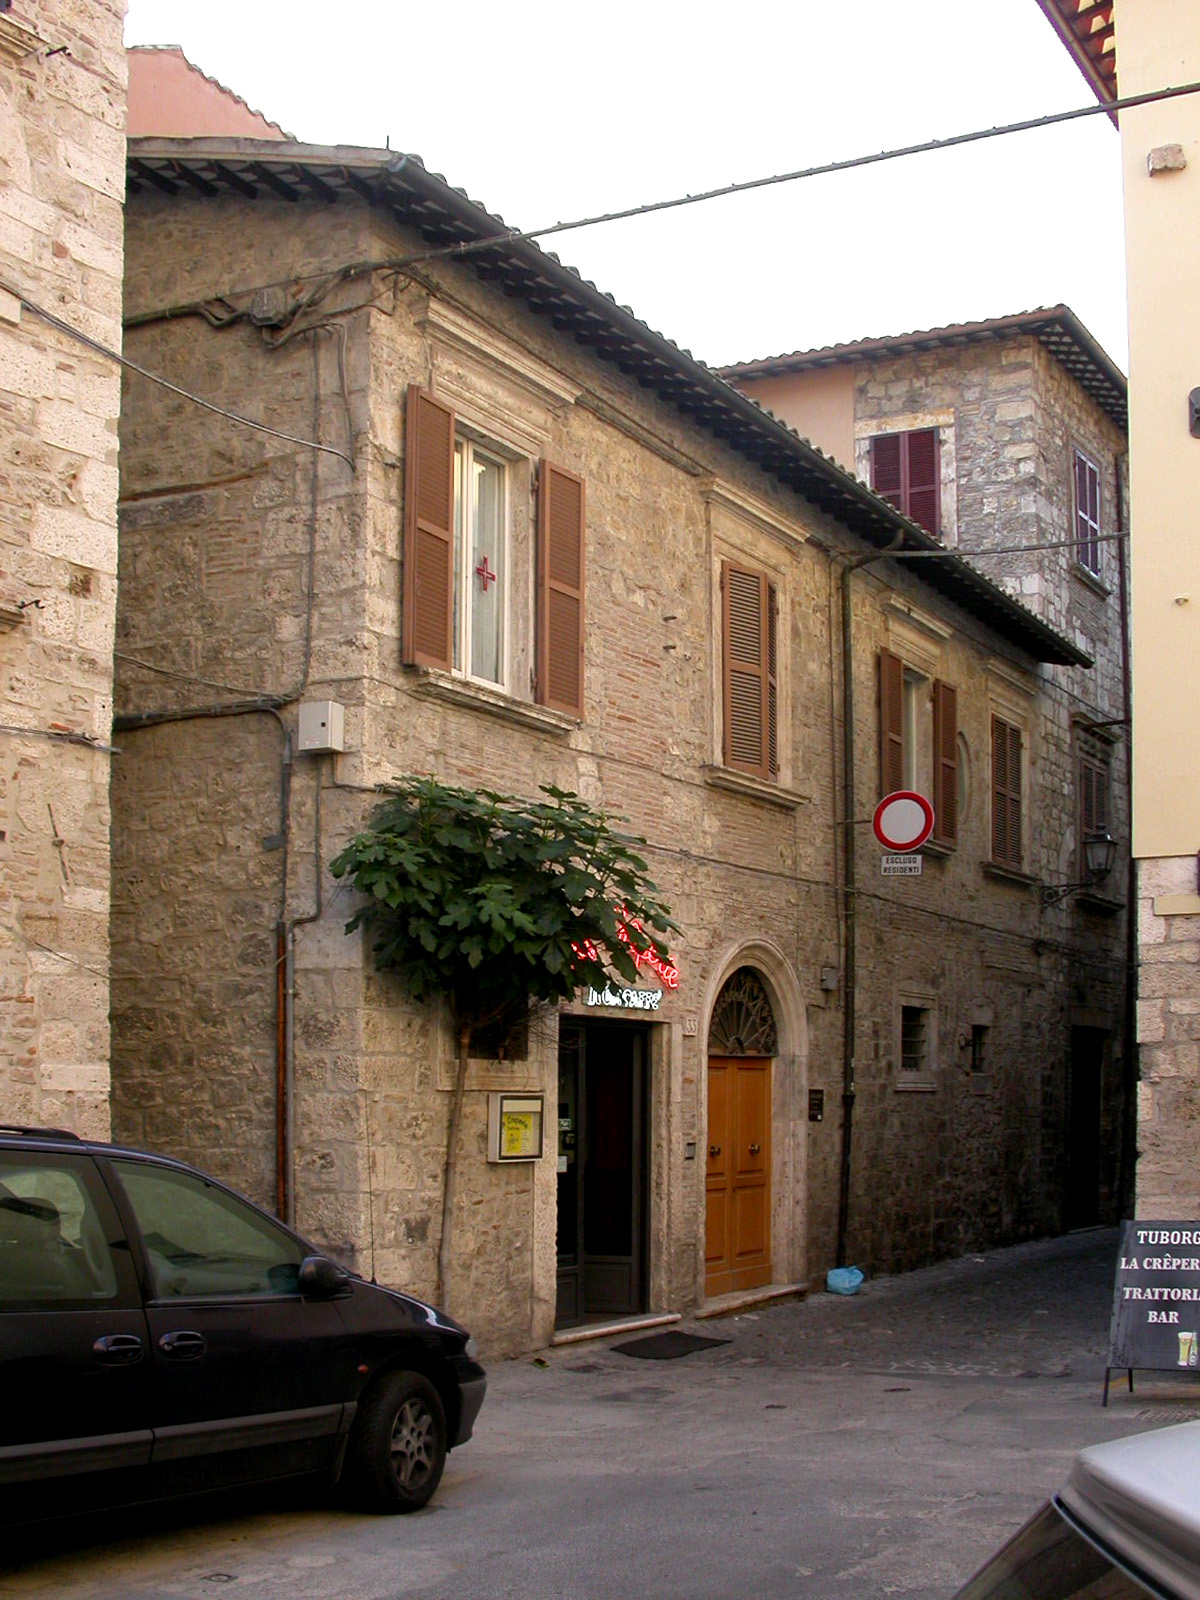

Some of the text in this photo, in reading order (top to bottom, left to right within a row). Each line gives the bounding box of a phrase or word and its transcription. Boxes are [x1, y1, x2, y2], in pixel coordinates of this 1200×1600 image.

[886, 856, 917, 864] ESCLUSO
[883, 866, 920, 874] RESIDENTI
[686, 1019, 697, 1033] 33
[1137, 1230, 1200, 1245] TUBORG
[1120, 1257, 1140, 1270] LA
[1123, 1287, 1200, 1301] TRATTORI
[1147, 1310, 1179, 1324] BAR
